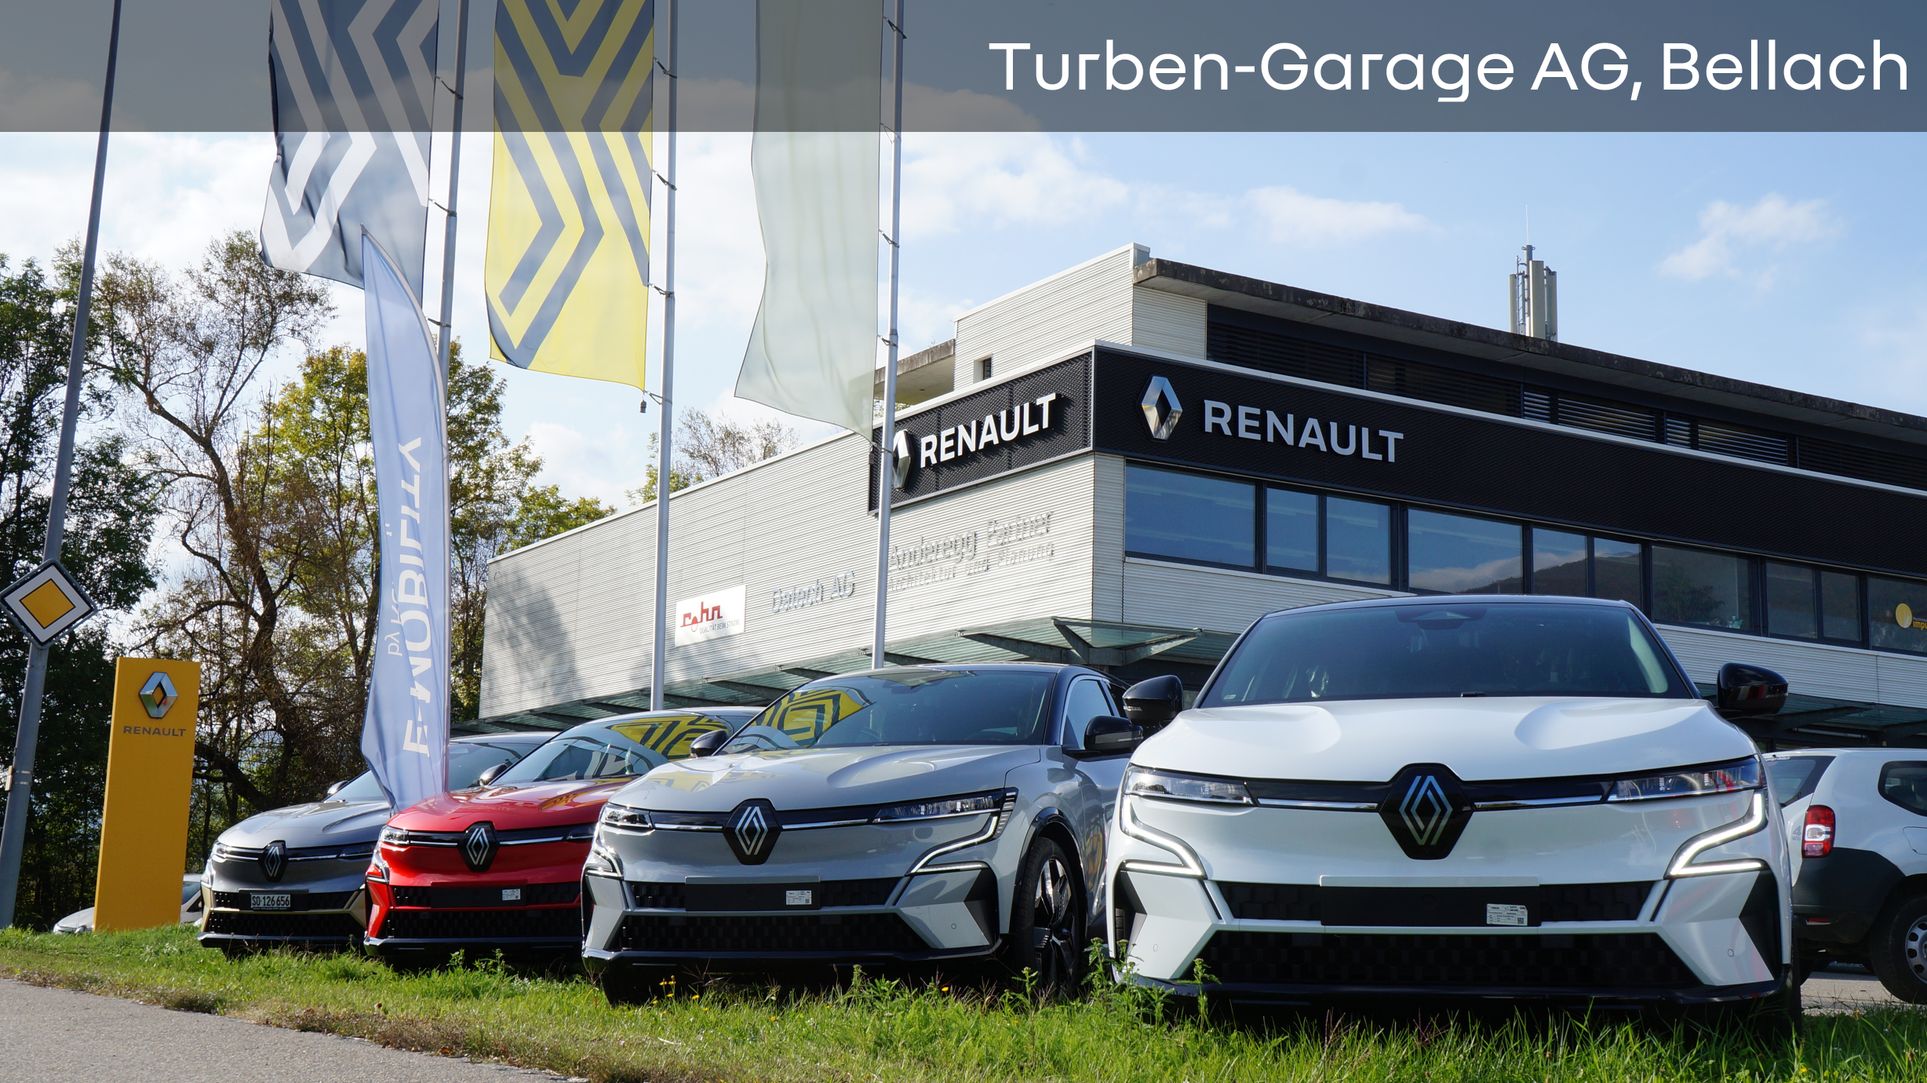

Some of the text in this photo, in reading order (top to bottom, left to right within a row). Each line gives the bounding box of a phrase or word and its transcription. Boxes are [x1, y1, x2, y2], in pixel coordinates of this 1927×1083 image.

[920, 392, 1057, 469] RENAULT
[1203, 399, 1405, 463] RENAULT
[888, 531, 978, 570] Anderegg
[830, 570, 856, 600] AG
[123, 725, 187, 737] RENAULT
